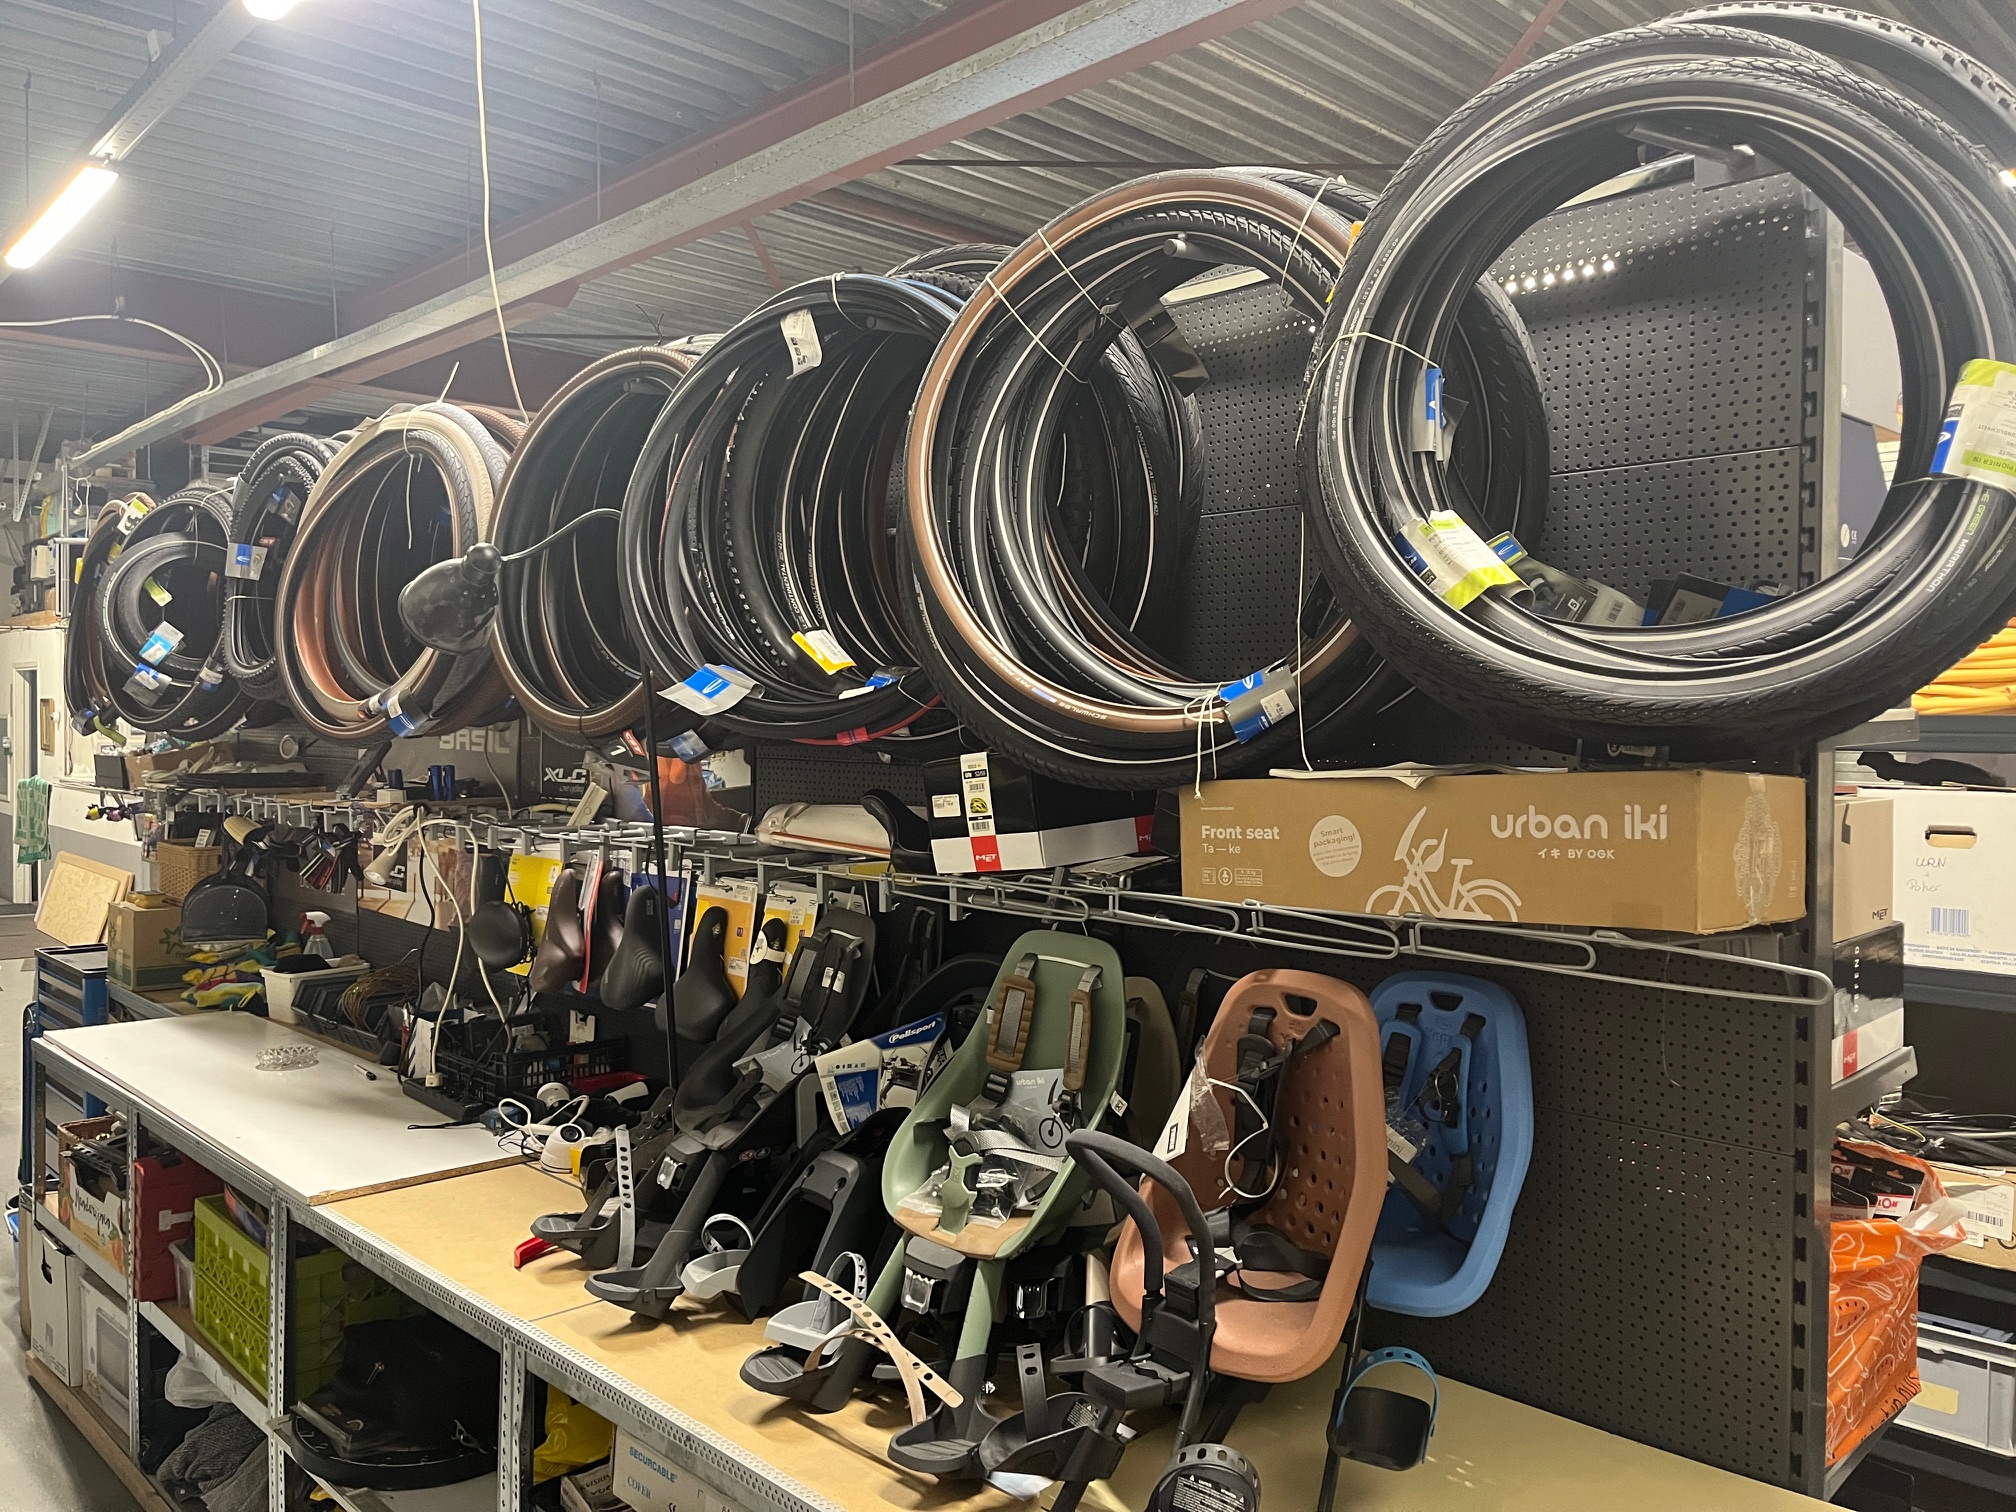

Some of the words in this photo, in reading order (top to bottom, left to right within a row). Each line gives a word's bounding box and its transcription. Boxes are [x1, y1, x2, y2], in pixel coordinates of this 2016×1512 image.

[1966, 504, 1986, 536] GREEN
[1926, 538, 1969, 593] MARATHON
[1058, 701, 1107, 720] SCHWALBE
[439, 728, 511, 754] BASIL
[543, 767, 587, 783] XLC
[1490, 804, 1608, 840] urban
[1624, 804, 1668, 840] iki
[1201, 825, 1242, 839] Front
[1246, 826, 1280, 840] seat
[1320, 827, 1344, 838] Smart
[1202, 843, 1214, 854] Ta
[1229, 843, 1241, 854] ke
[1313, 833, 1356, 849] packaging!
[975, 853, 997, 862] MET
[1567, 848, 1584, 860] BY
[1587, 848, 1616, 860] OGK
[1872, 908, 1890, 921] MET
[888, 1021, 936, 1044] Polisport
[1843, 1052, 1857, 1064] MET
[629, 1446, 676, 1483] SECURCABLE
